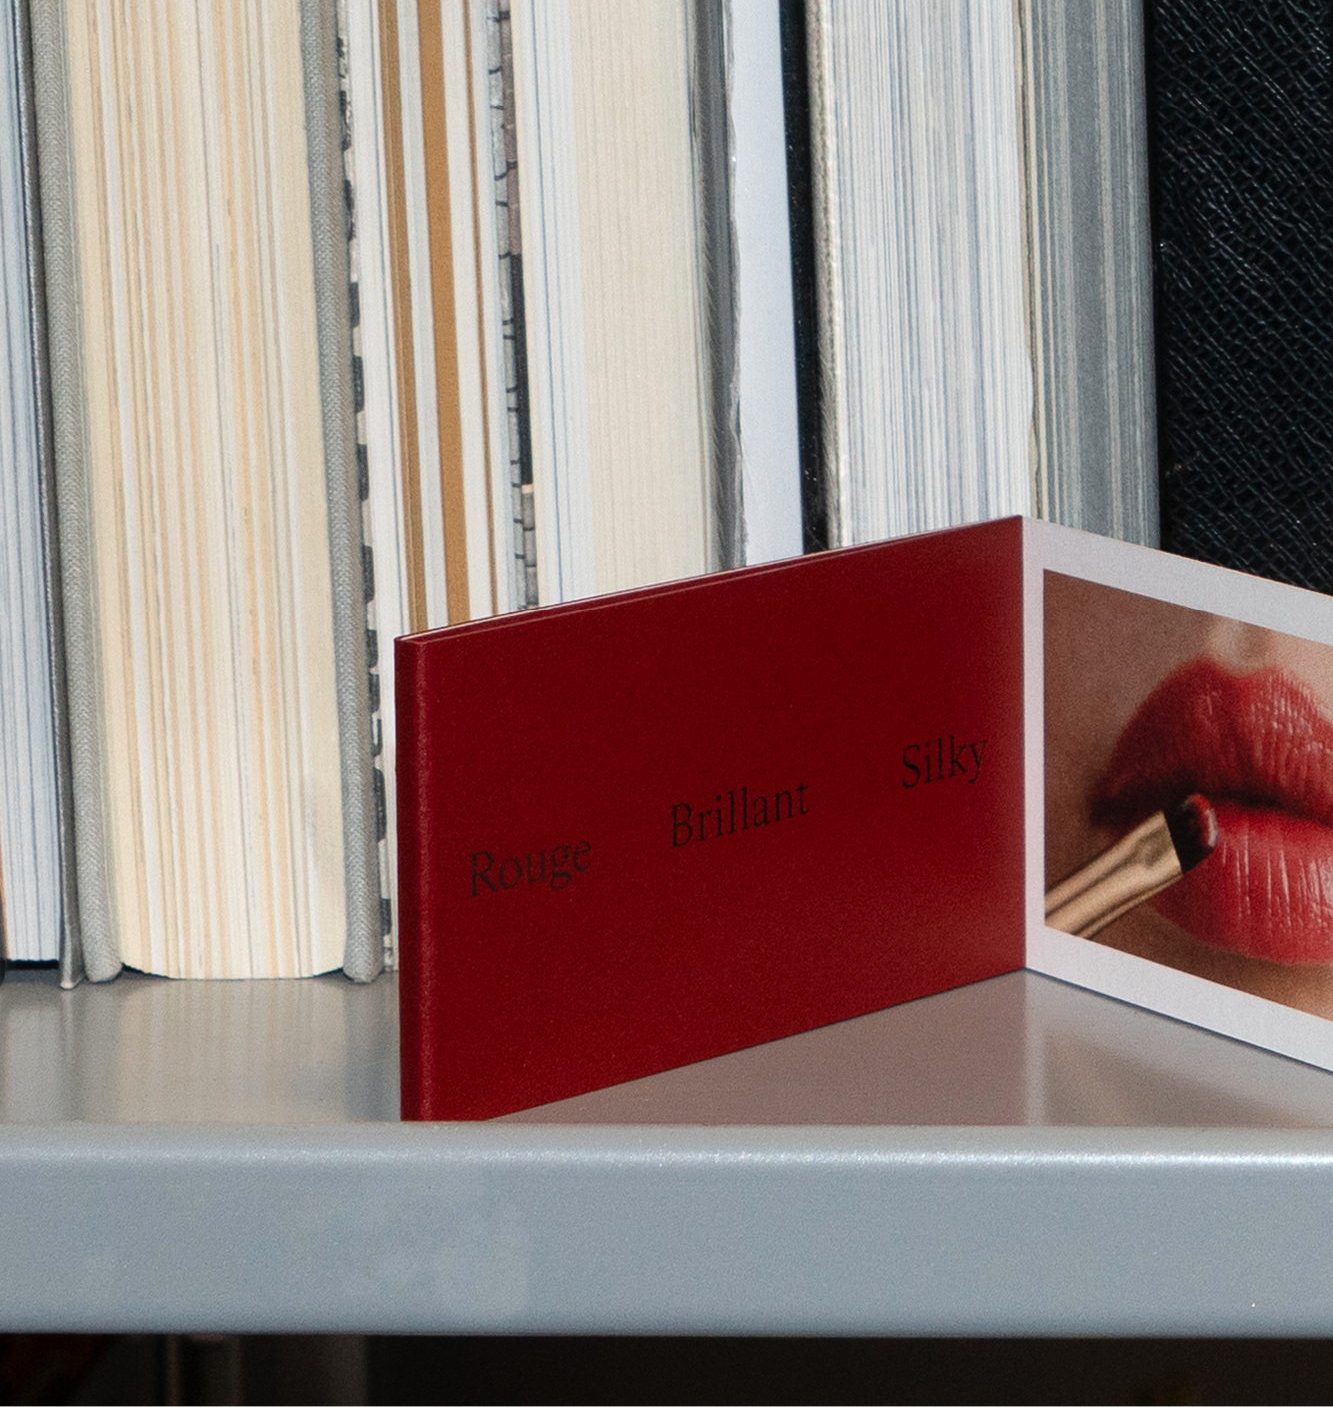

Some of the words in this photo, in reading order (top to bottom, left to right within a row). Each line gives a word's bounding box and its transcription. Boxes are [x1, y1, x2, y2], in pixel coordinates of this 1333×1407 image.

[467, 838, 593, 897] Rouge
[668, 781, 810, 850] Brillant
[900, 734, 989, 790] Silky
